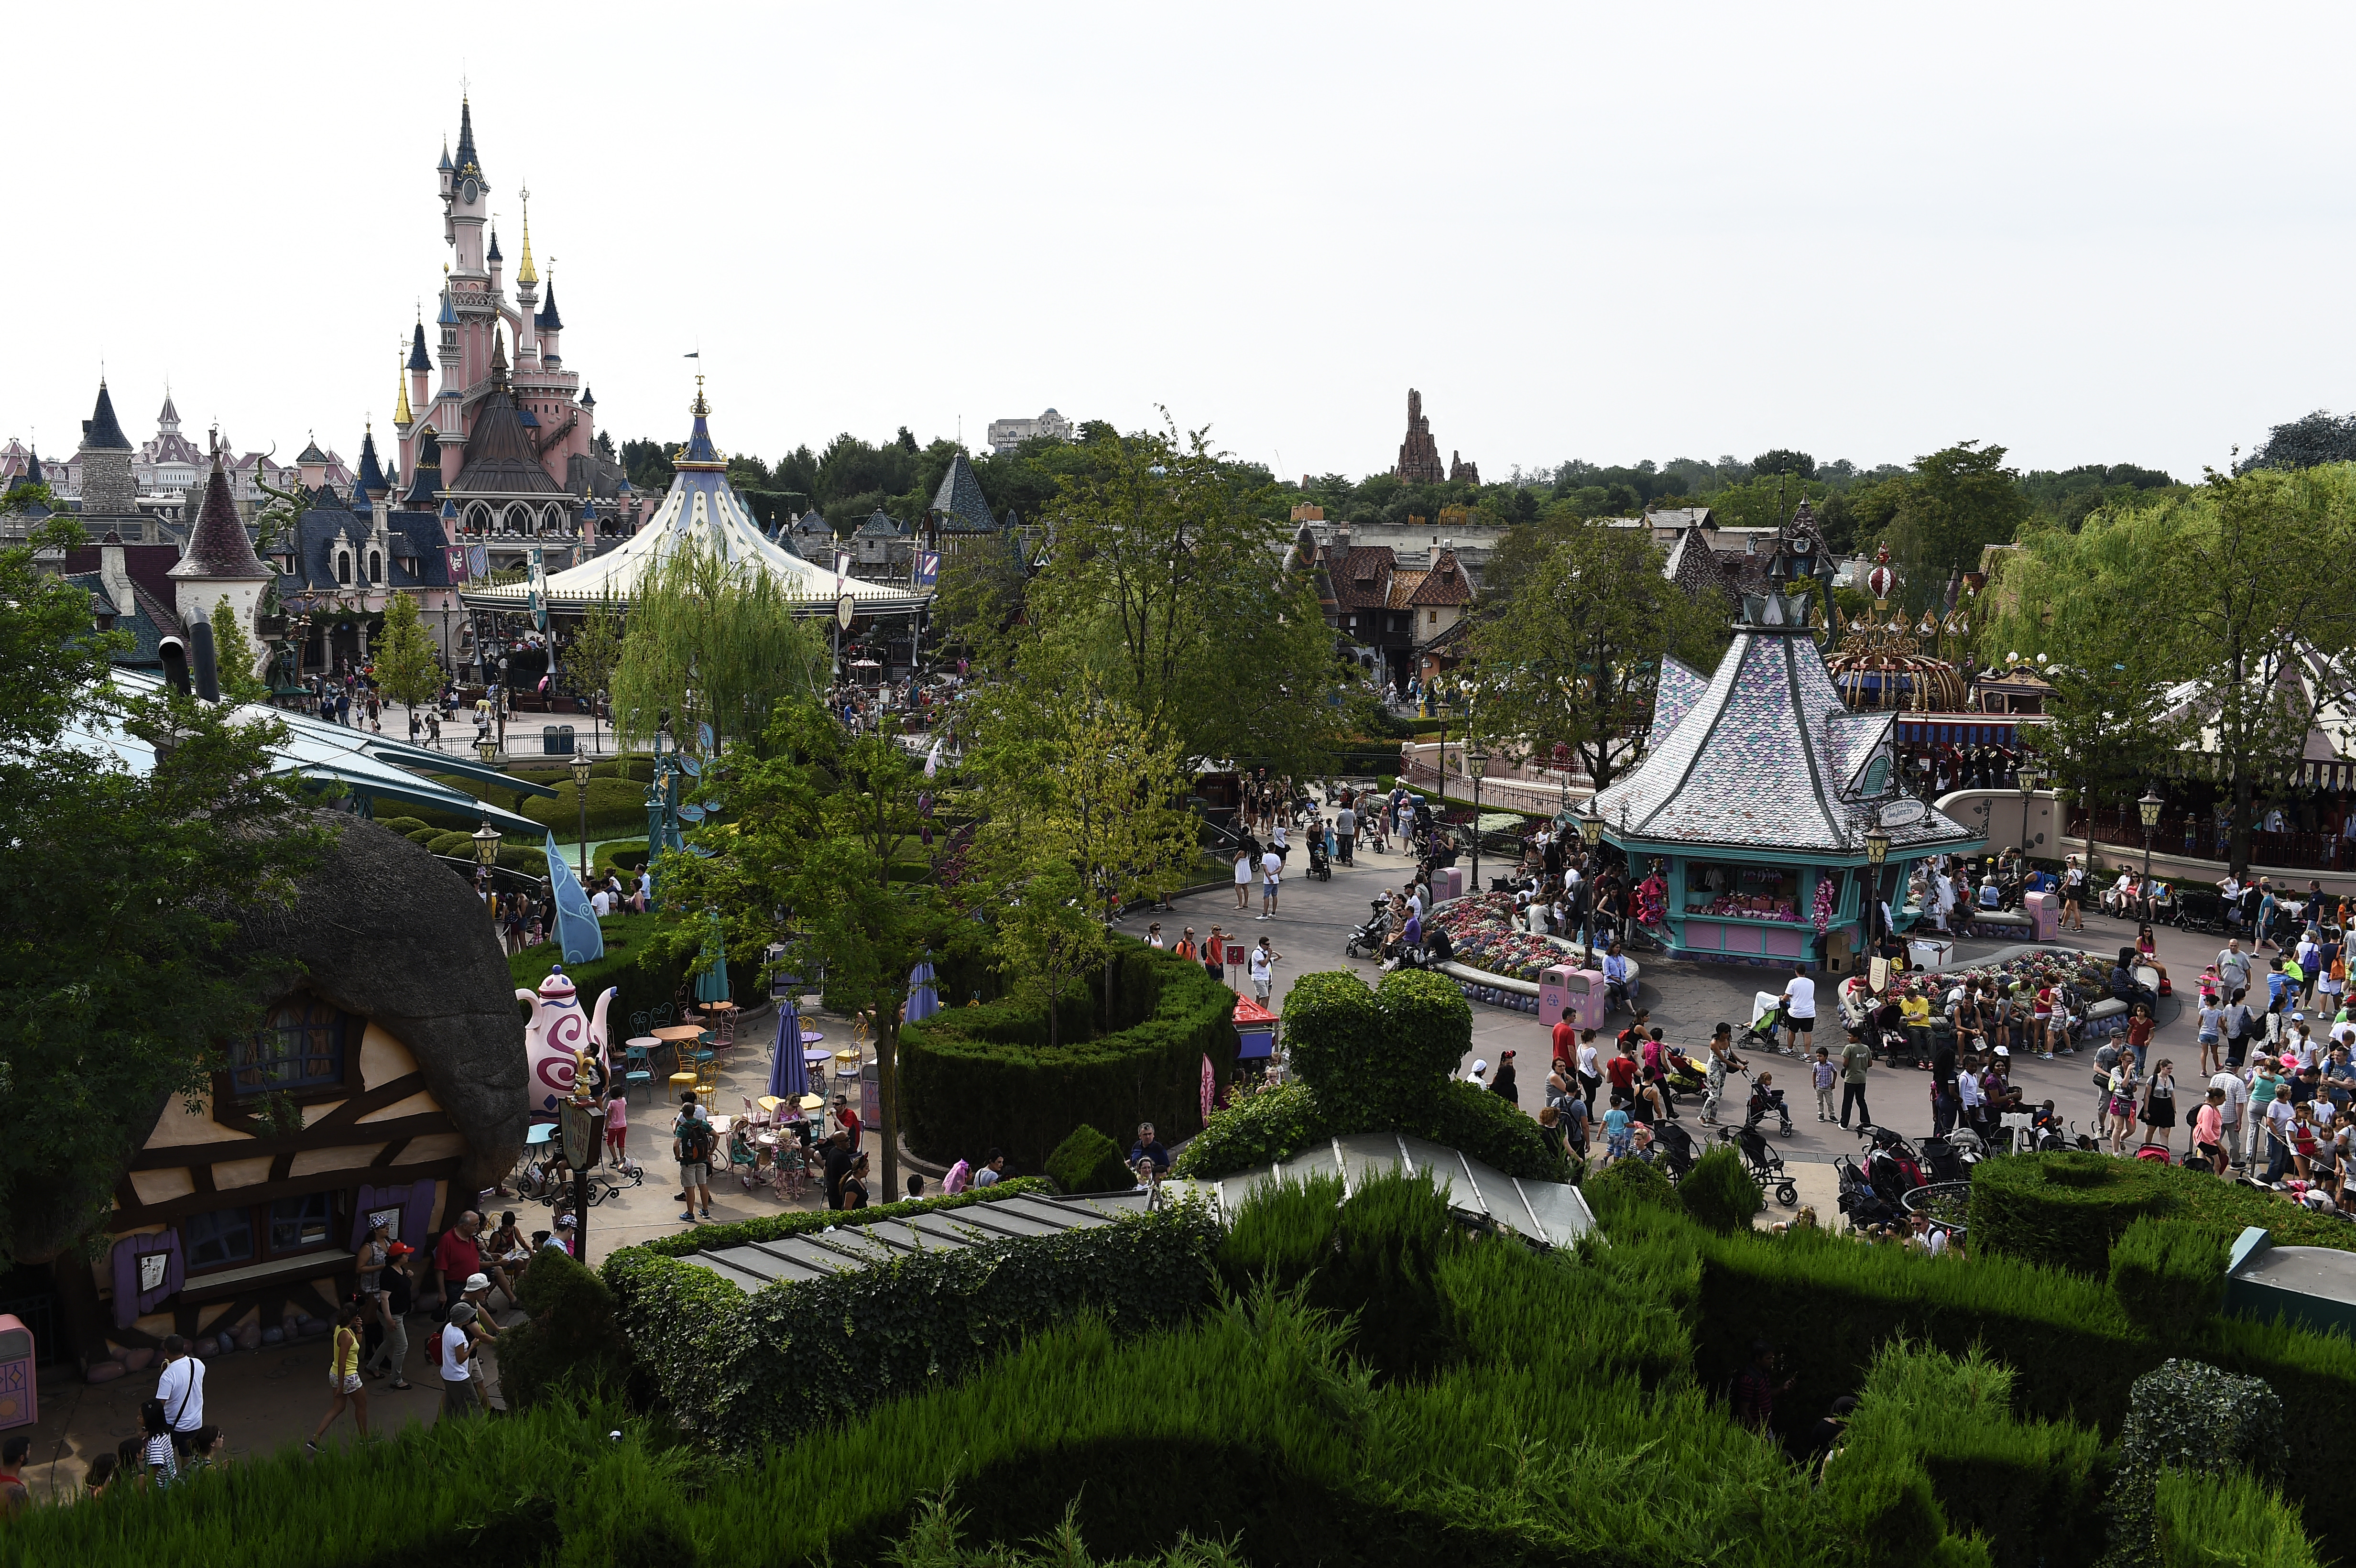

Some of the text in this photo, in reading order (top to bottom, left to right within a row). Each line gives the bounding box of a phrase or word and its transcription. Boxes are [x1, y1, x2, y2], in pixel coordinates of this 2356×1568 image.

[1895, 808, 1913, 818] JOUETS
[563, 1110, 589, 1136] MARCH
[566, 1130, 587, 1157] HARE
